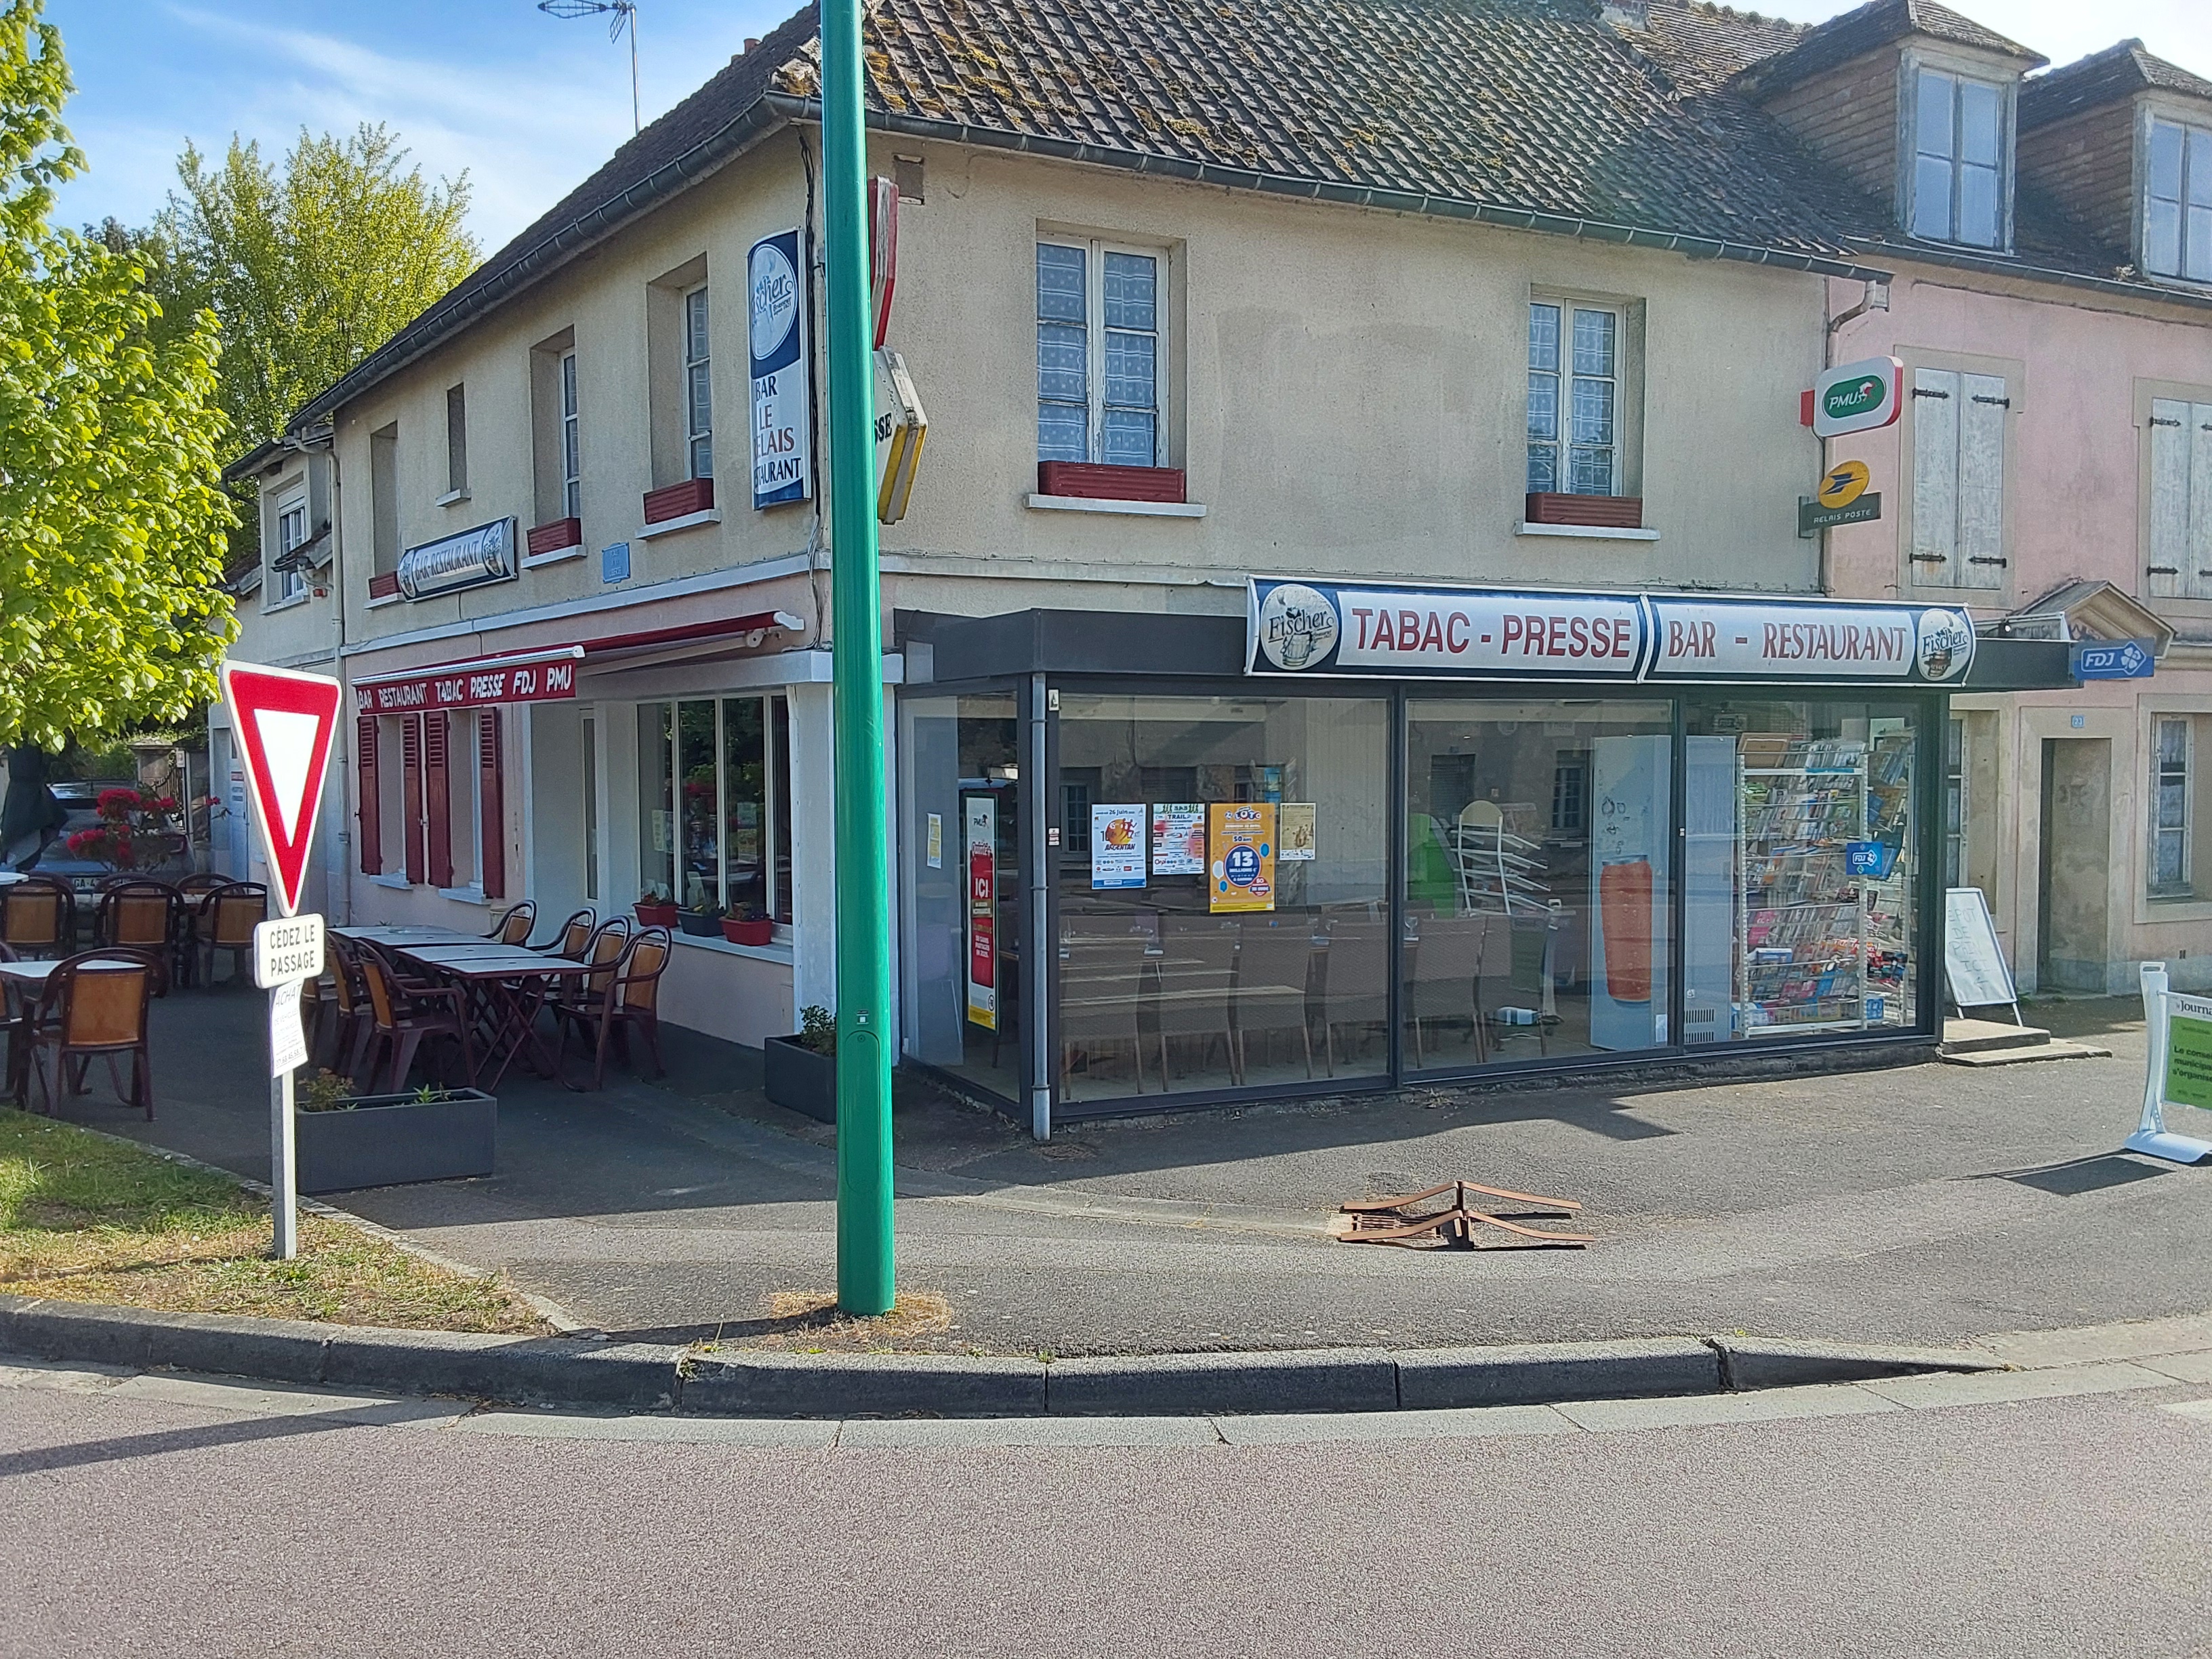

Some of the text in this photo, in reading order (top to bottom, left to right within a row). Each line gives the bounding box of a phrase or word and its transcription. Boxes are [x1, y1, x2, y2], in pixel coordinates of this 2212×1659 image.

[756, 375, 778, 402] BAR
[1828, 391, 1860, 410] PMU
[760, 404, 773, 430] LE
[1814, 509, 1871, 524] RELAIS POSTE
[1269, 609, 1327, 640] Fischer
[1352, 607, 1471, 653] TABAC
[1501, 614, 1631, 658] PRESSE
[1668, 620, 1716, 657] BAR
[1762, 622, 1907, 661] RESTAURANT
[1923, 628, 1964, 655] Fischer
[2085, 652, 2115, 667] FDJ
[359, 664, 572, 710] BAR RESTAURANT TABAC PRESSE FDJ PMU
[1235, 810, 1261, 820] LOTO
[1232, 851, 1253, 867] 13
[975, 878, 989, 899] ICI
[270, 924, 314, 949] CÉDEZ LE
[271, 950, 314, 977] PASSAGE
[276, 984, 302, 1007] ACHAT
[2174, 1045, 2184, 1054] Le
